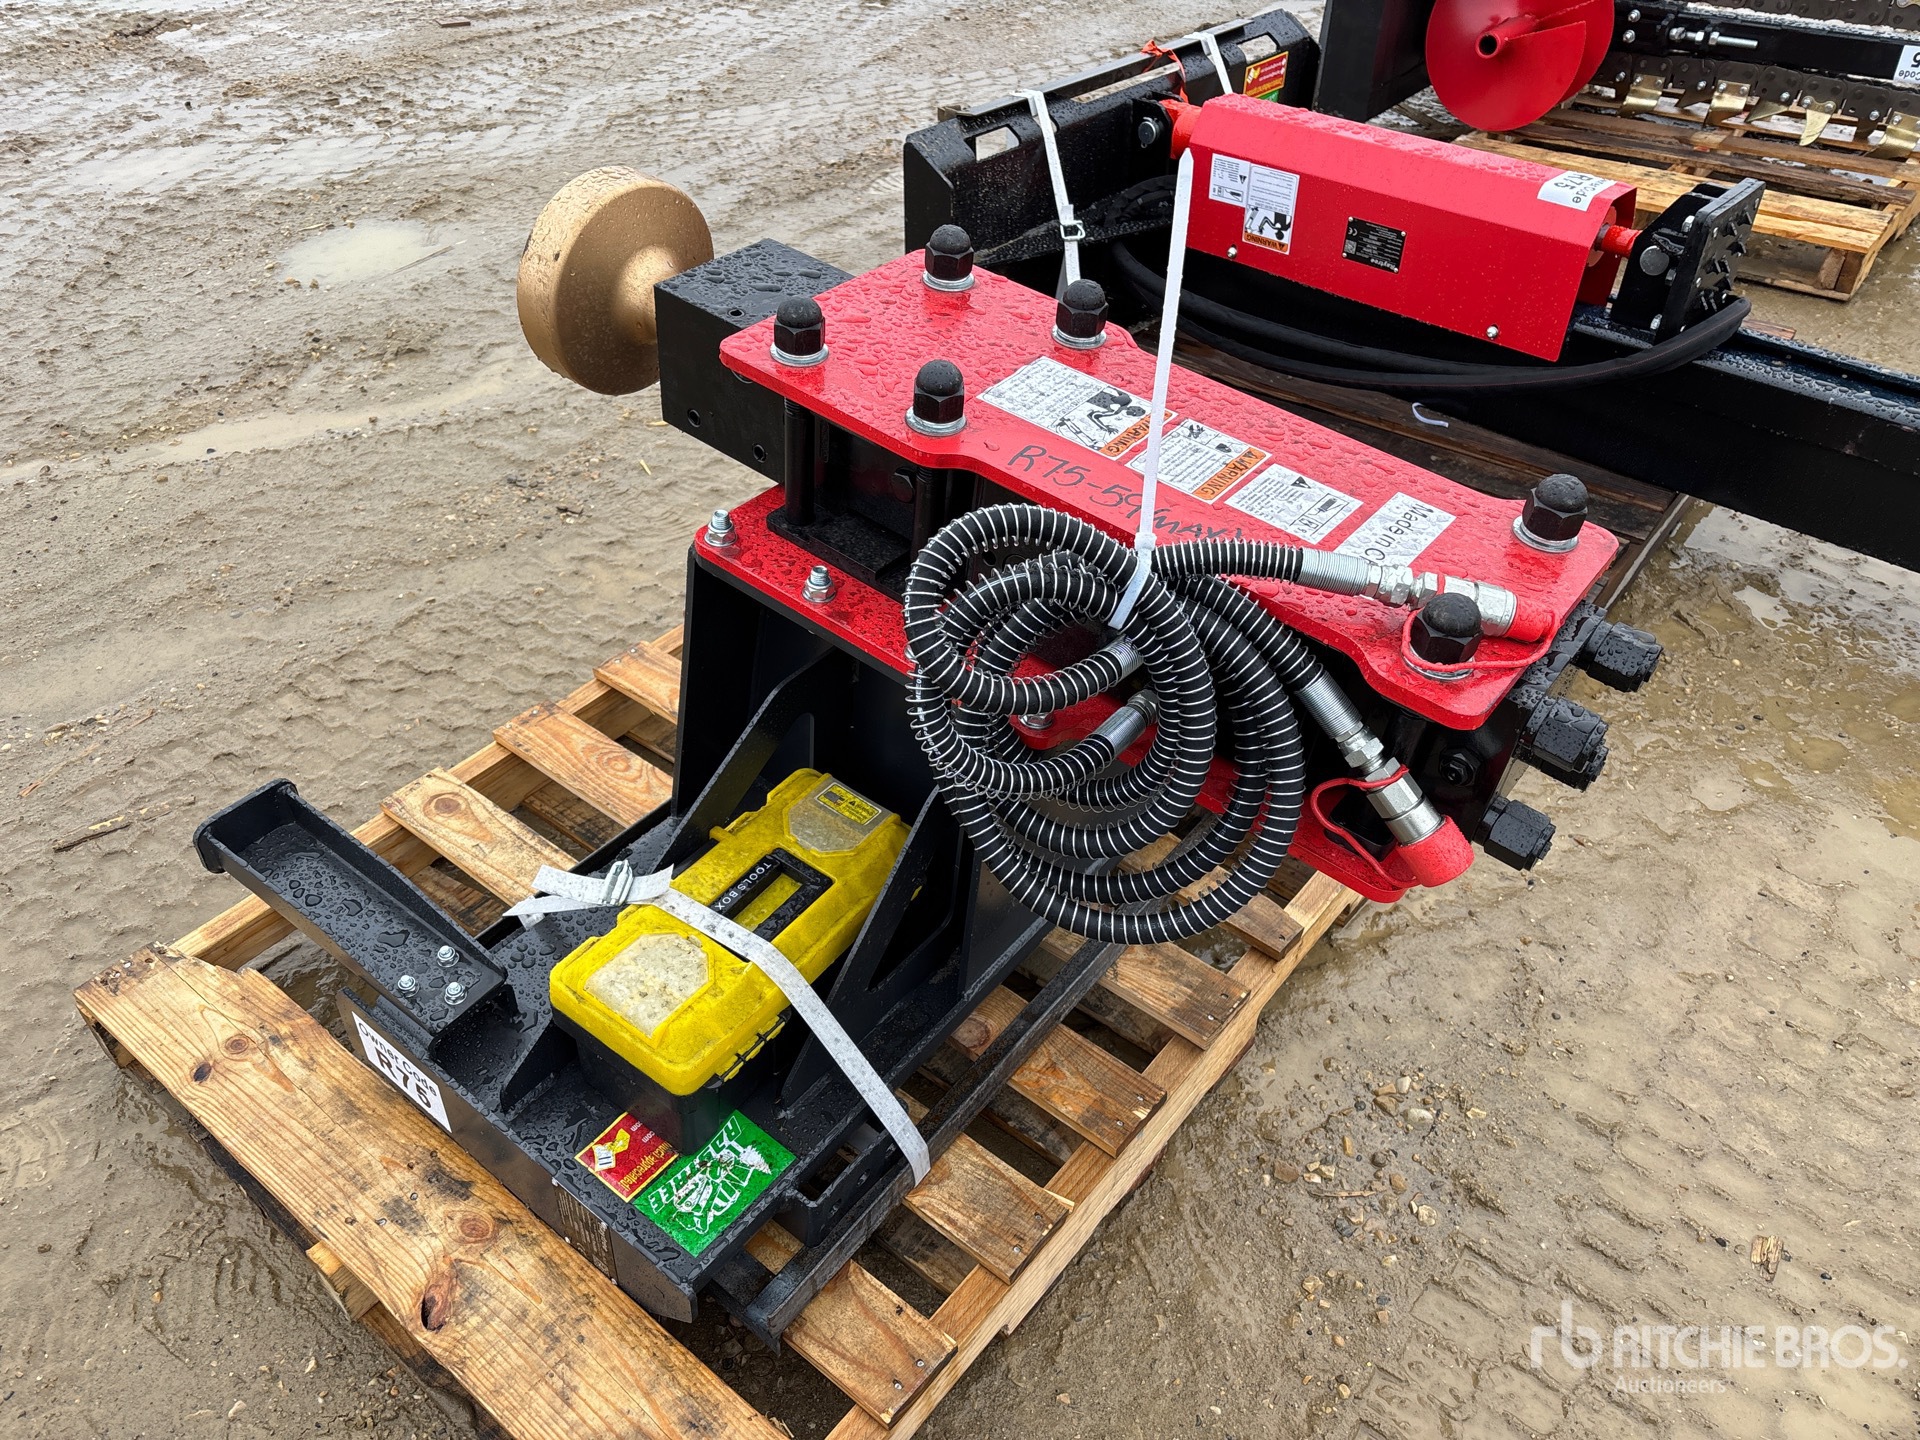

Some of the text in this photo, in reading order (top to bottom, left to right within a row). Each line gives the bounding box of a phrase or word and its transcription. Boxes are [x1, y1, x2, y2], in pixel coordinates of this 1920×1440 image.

[1246, 234, 1277, 249] WARNING
[1201, 458, 1252, 495] WARNING
[1389, 503, 1434, 536] Made
[1375, 534, 1401, 548] in
[714, 862, 772, 910] TOOLS BOX
[359, 1022, 437, 1097] Owner Code
[374, 1047, 432, 1109] R75
